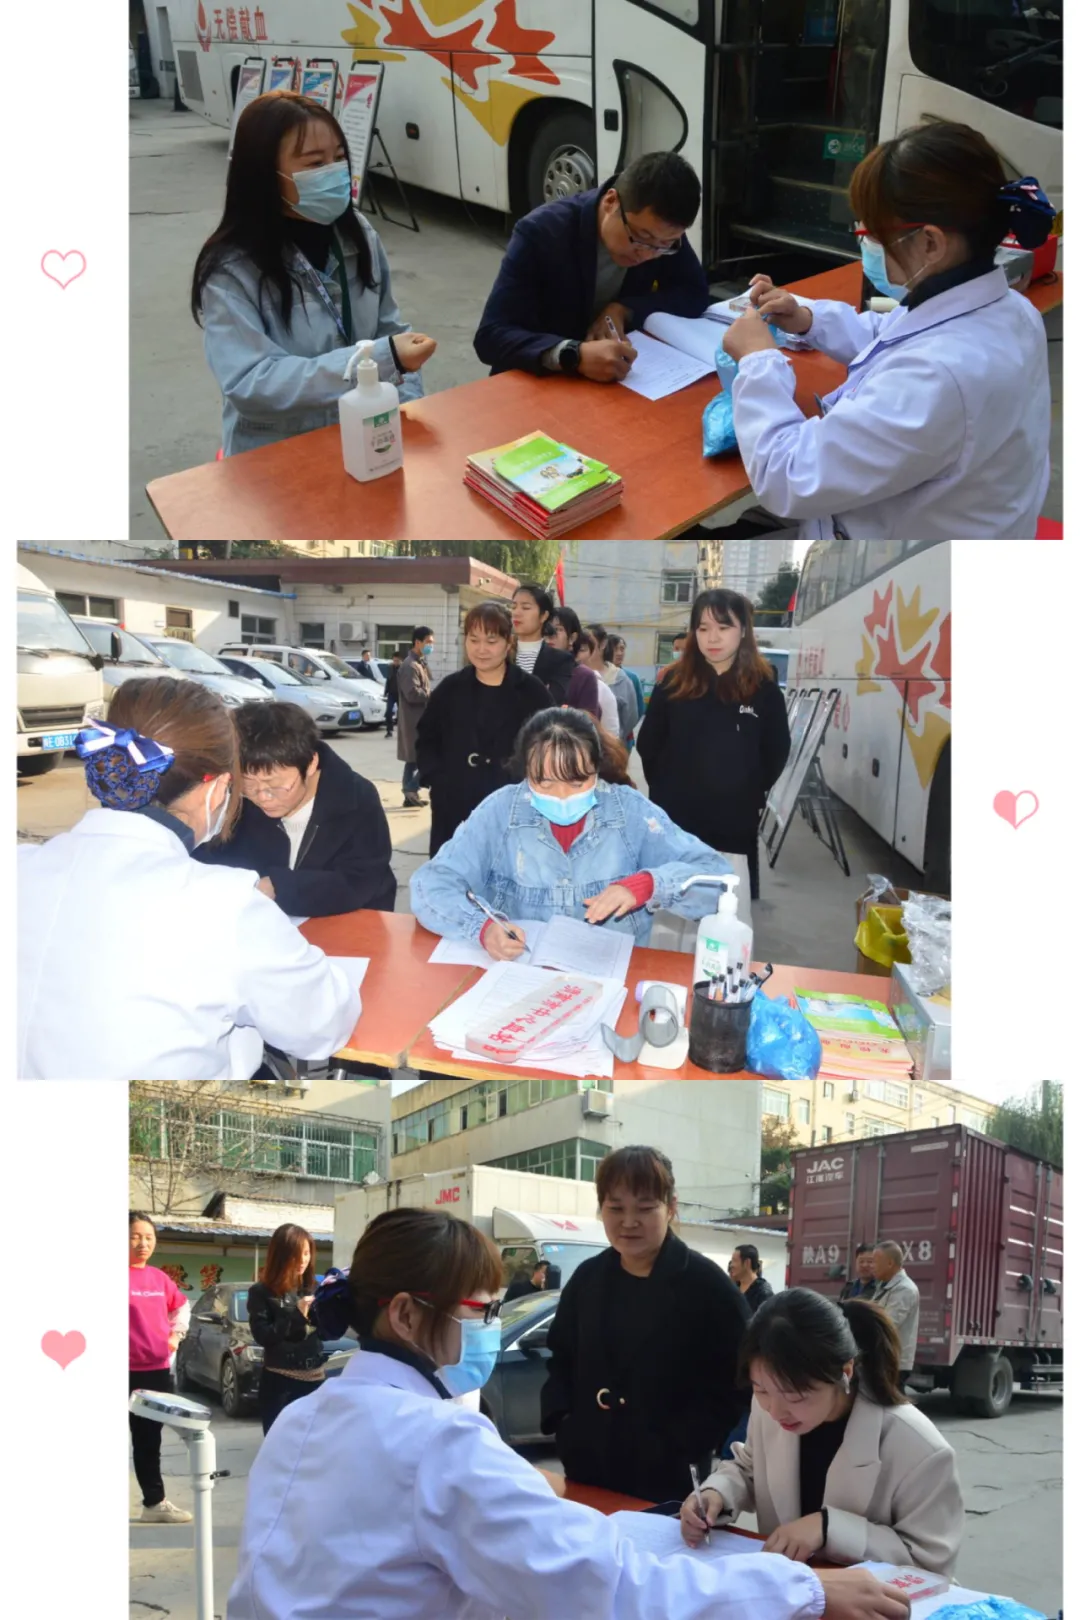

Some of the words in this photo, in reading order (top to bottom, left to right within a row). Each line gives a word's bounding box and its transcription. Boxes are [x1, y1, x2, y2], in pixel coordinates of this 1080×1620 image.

[806, 1157, 845, 1174] JAC
[806, 1171, 844, 1185] 江淮汽车
[435, 1186, 460, 1205] JMC
